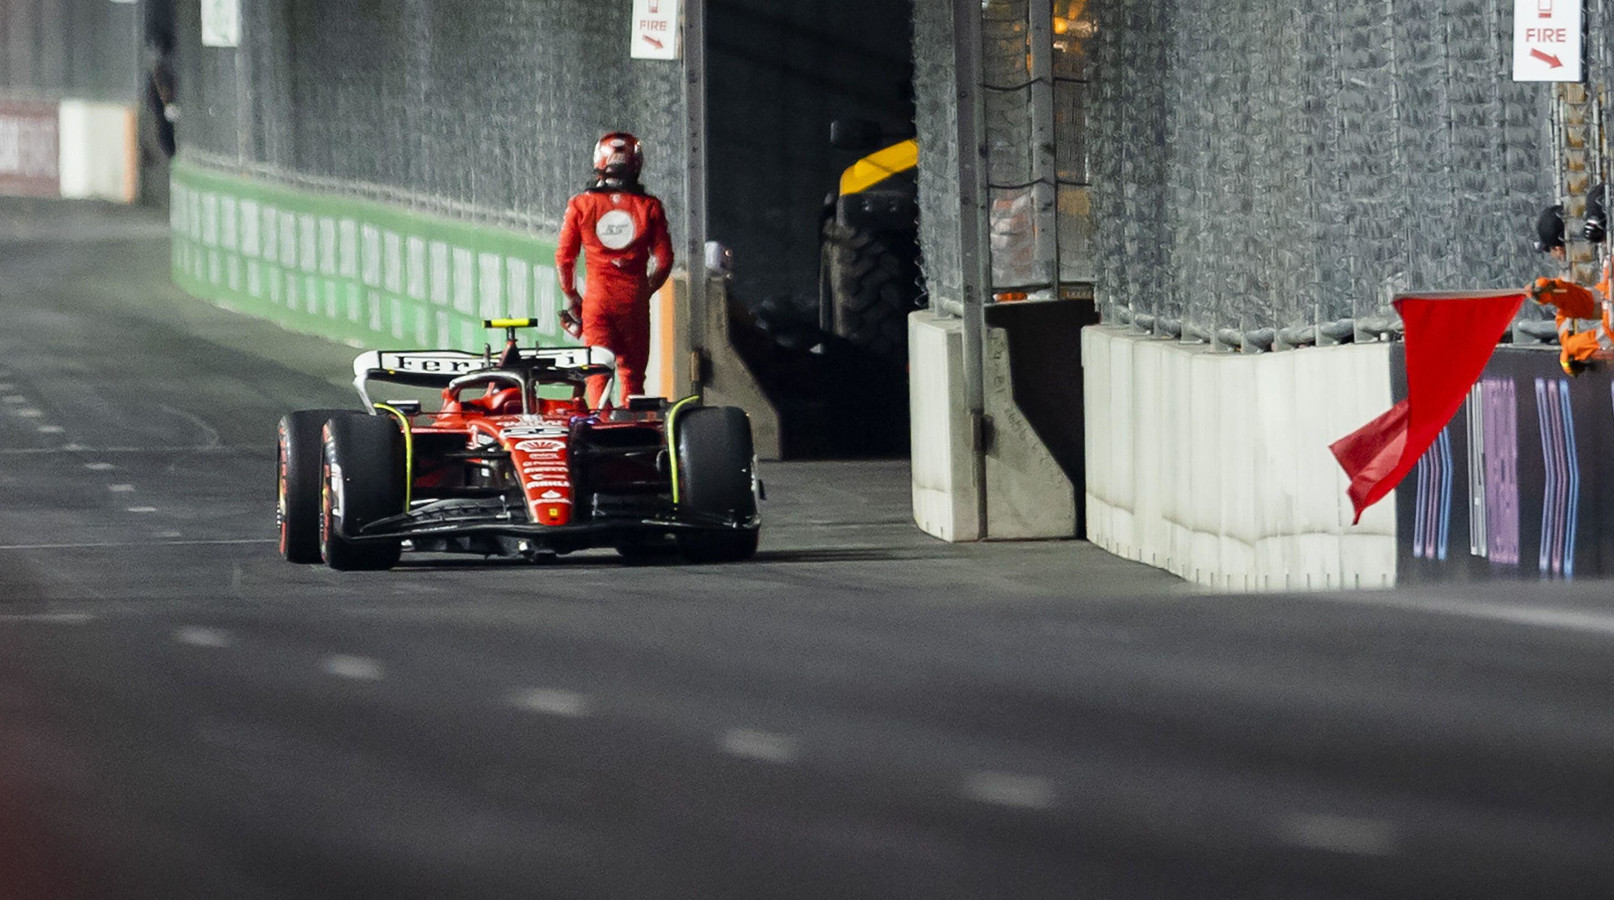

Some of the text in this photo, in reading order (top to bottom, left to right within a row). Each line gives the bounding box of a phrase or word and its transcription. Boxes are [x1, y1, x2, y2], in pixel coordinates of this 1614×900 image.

[640, 20, 667, 31] FIRE
[1526, 28, 1566, 42] FIRE
[394, 351, 576, 373] Feri
